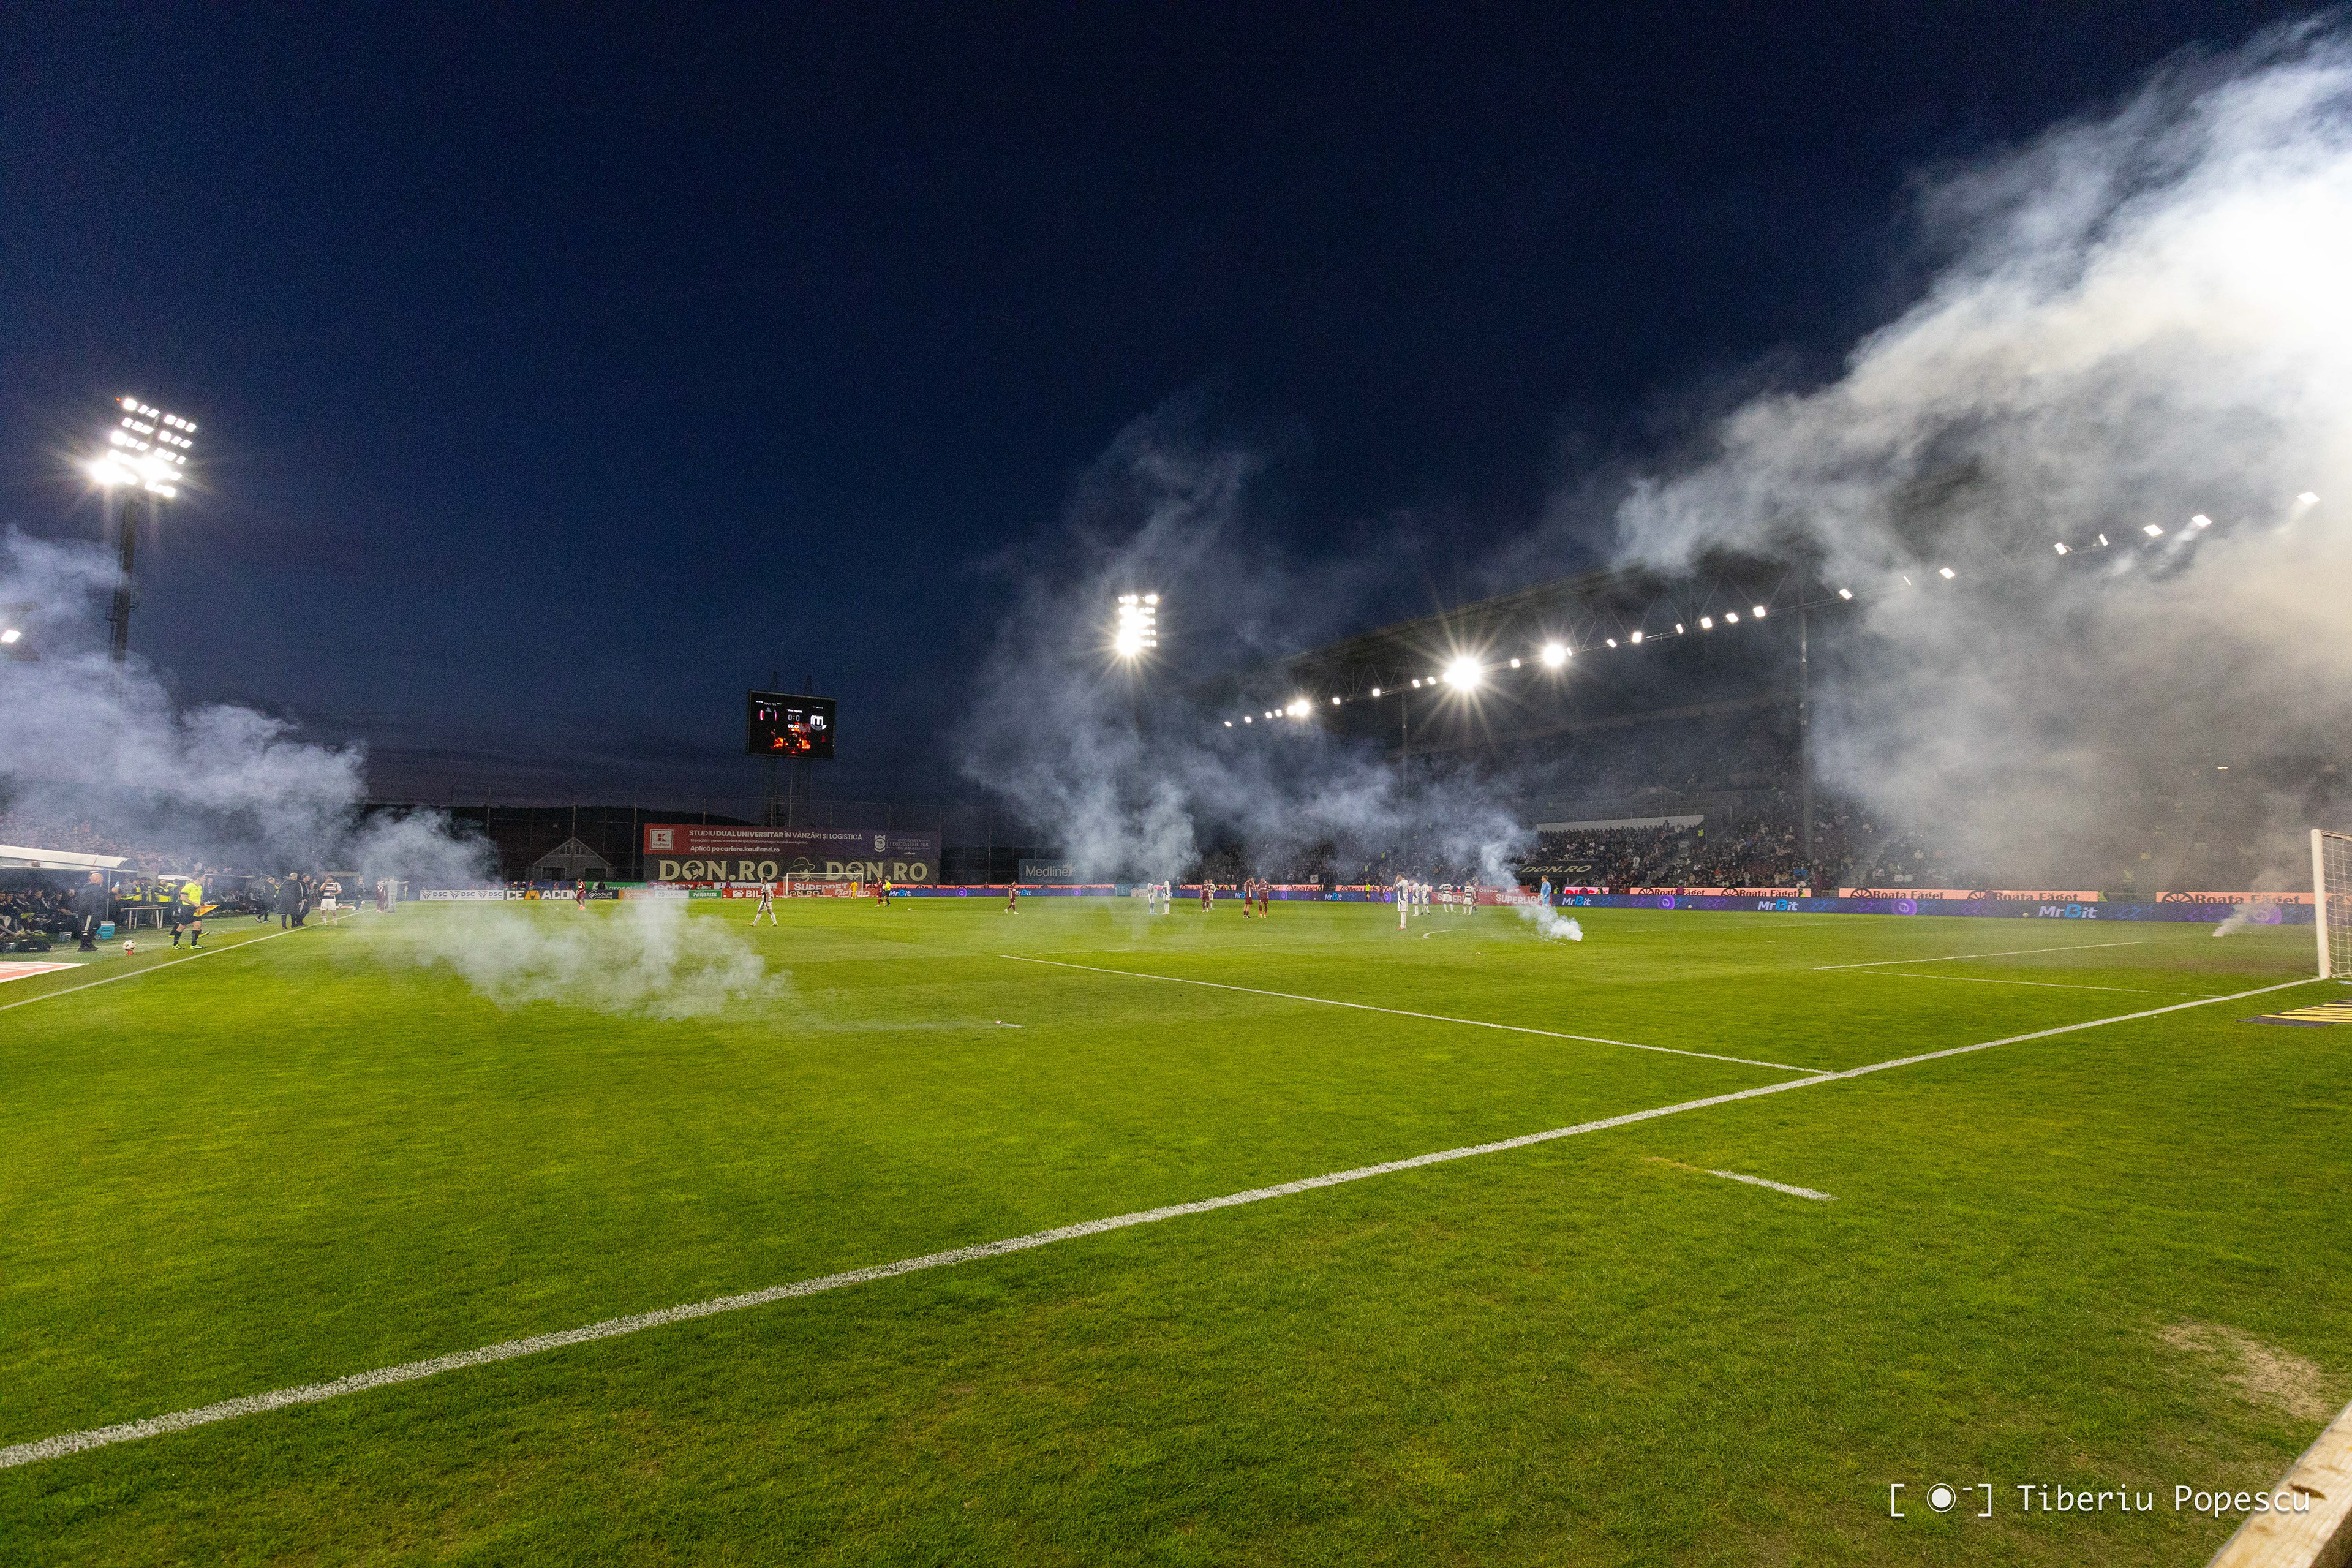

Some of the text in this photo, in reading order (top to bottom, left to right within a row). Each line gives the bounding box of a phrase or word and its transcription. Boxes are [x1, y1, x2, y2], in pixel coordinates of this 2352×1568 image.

[658, 860, 778, 881] DON.RO
[826, 861, 927, 881] DON.RO
[1025, 865, 1069, 876] Medline
[1562, 895, 1592, 906] MrBit
[1996, 892, 2034, 901] Roata
[2195, 894, 2244, 904] Roata
[1758, 899, 1799, 911] MrBit
[2038, 904, 2098, 918] MrBit
